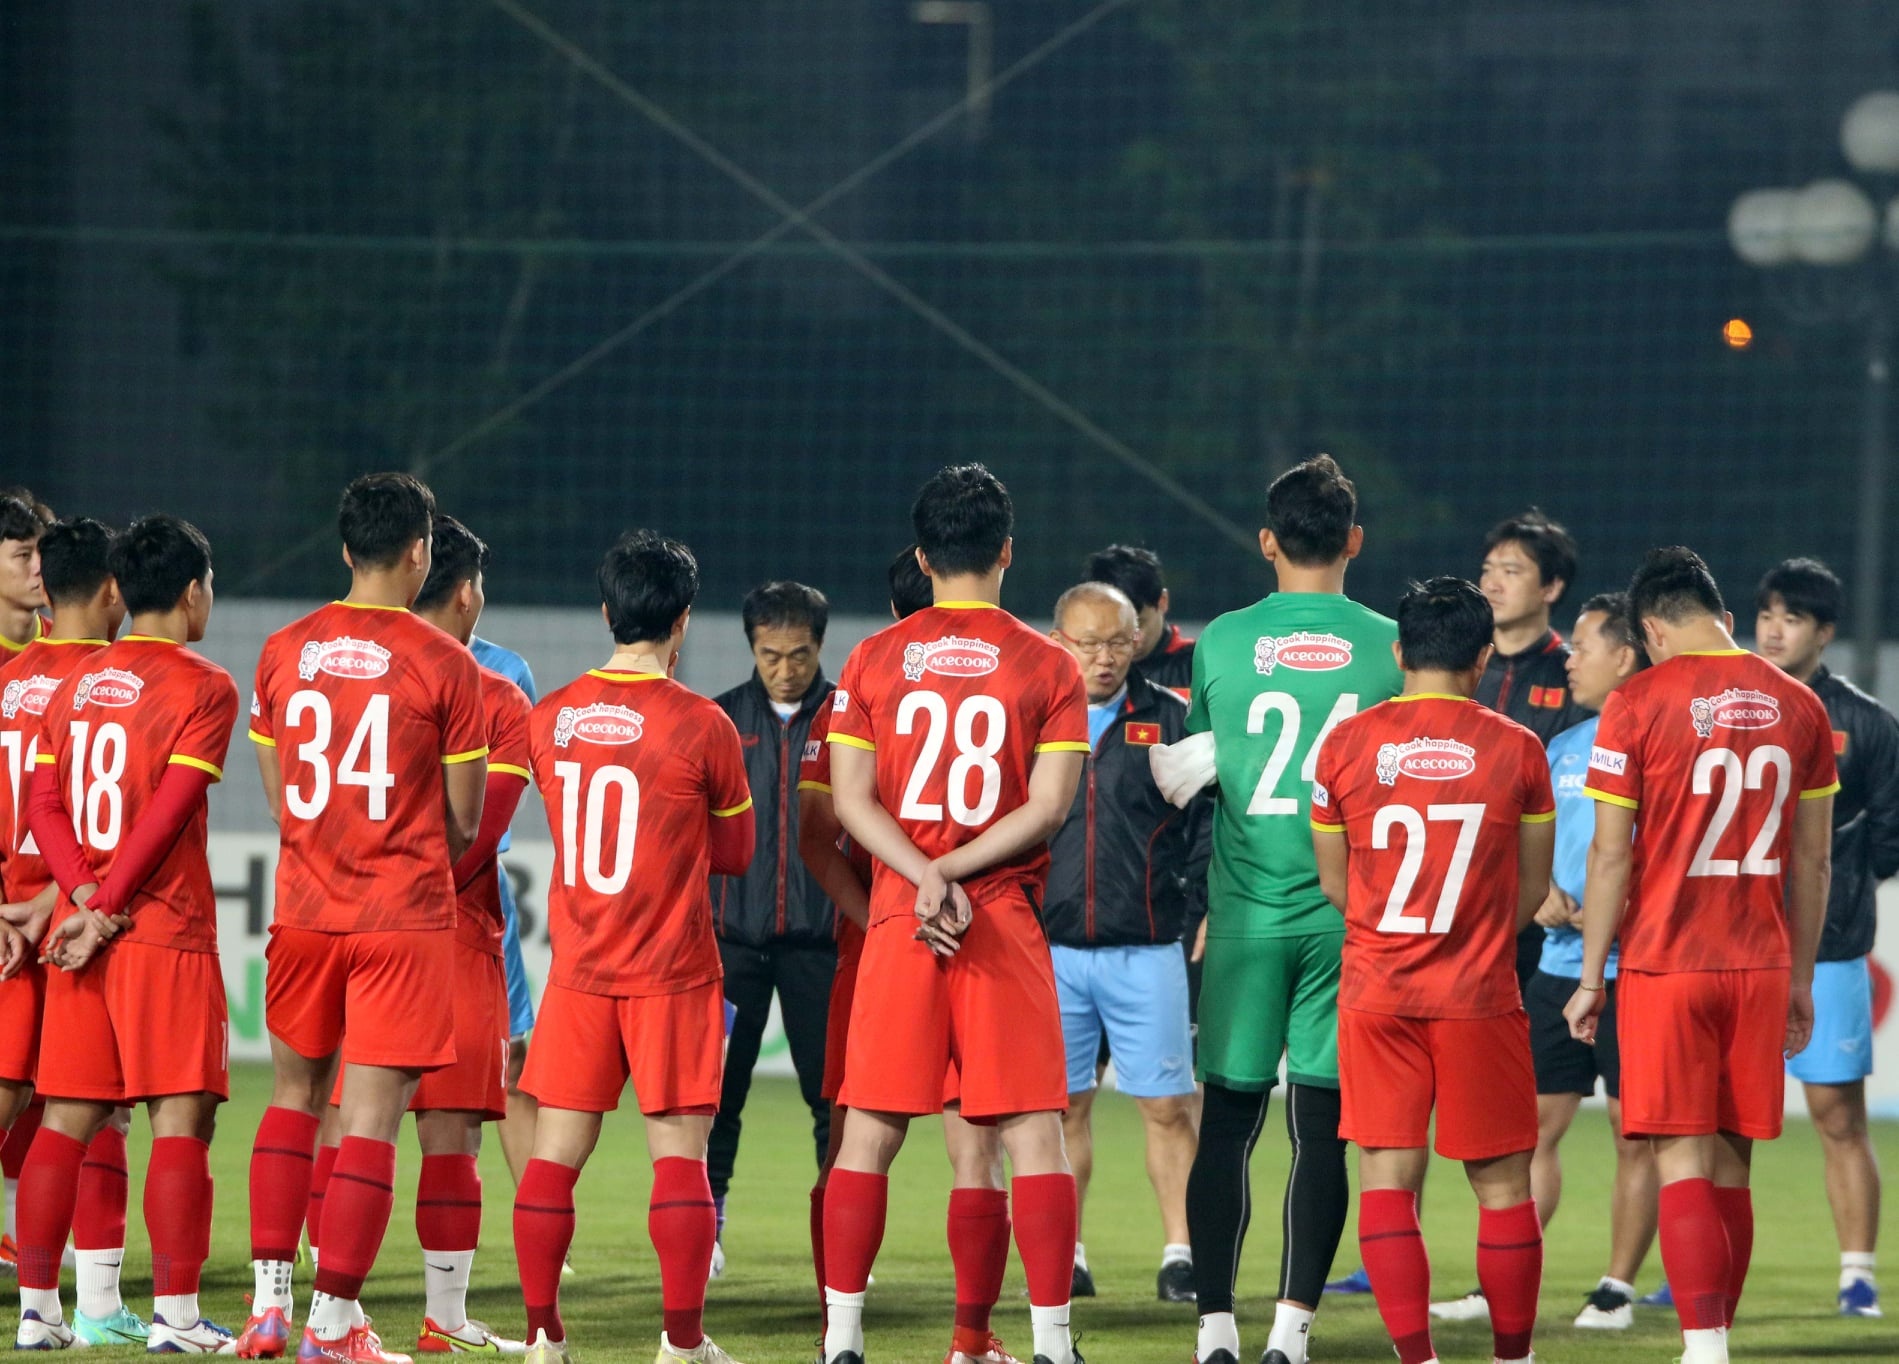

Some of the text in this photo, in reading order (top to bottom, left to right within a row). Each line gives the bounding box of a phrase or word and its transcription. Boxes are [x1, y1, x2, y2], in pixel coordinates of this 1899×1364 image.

[321, 638, 390, 658] Cook happiness
[926, 638, 997, 655] Cook happiness
[1277, 633, 1350, 649] Cook happiness
[1711, 689, 1777, 706] Cook happiness
[286, 690, 395, 820] 34
[576, 704, 642, 723] Cook happiness
[896, 690, 1006, 826] 28
[1399, 739, 1473, 755] Cook happiness
[1, 731, 40, 854] 1
[70, 721, 127, 850] 18
[555, 761, 640, 895] 10
[1686, 745, 1792, 877] 22
[1372, 803, 1486, 933] 27
